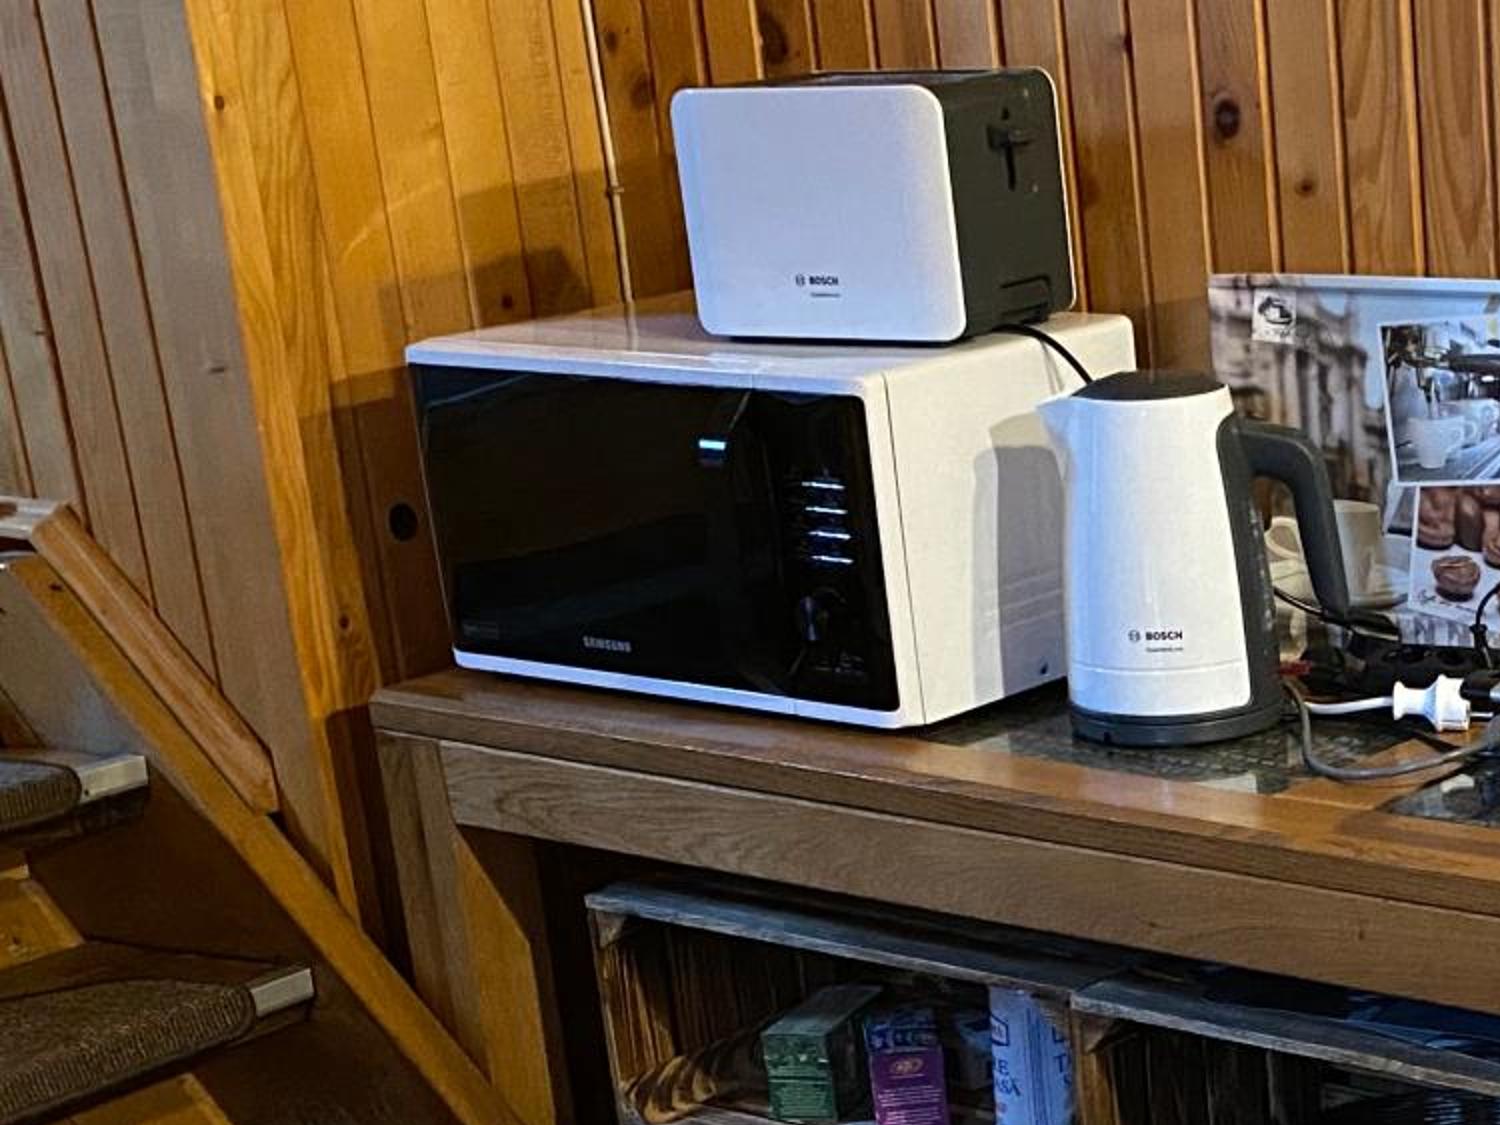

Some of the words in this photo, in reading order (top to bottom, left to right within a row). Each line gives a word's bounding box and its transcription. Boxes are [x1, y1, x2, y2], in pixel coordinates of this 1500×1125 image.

[809, 275, 839, 286] BOSCH
[1145, 631, 1183, 641] BOSCH
[582, 635, 632, 653] SAMSUNG
